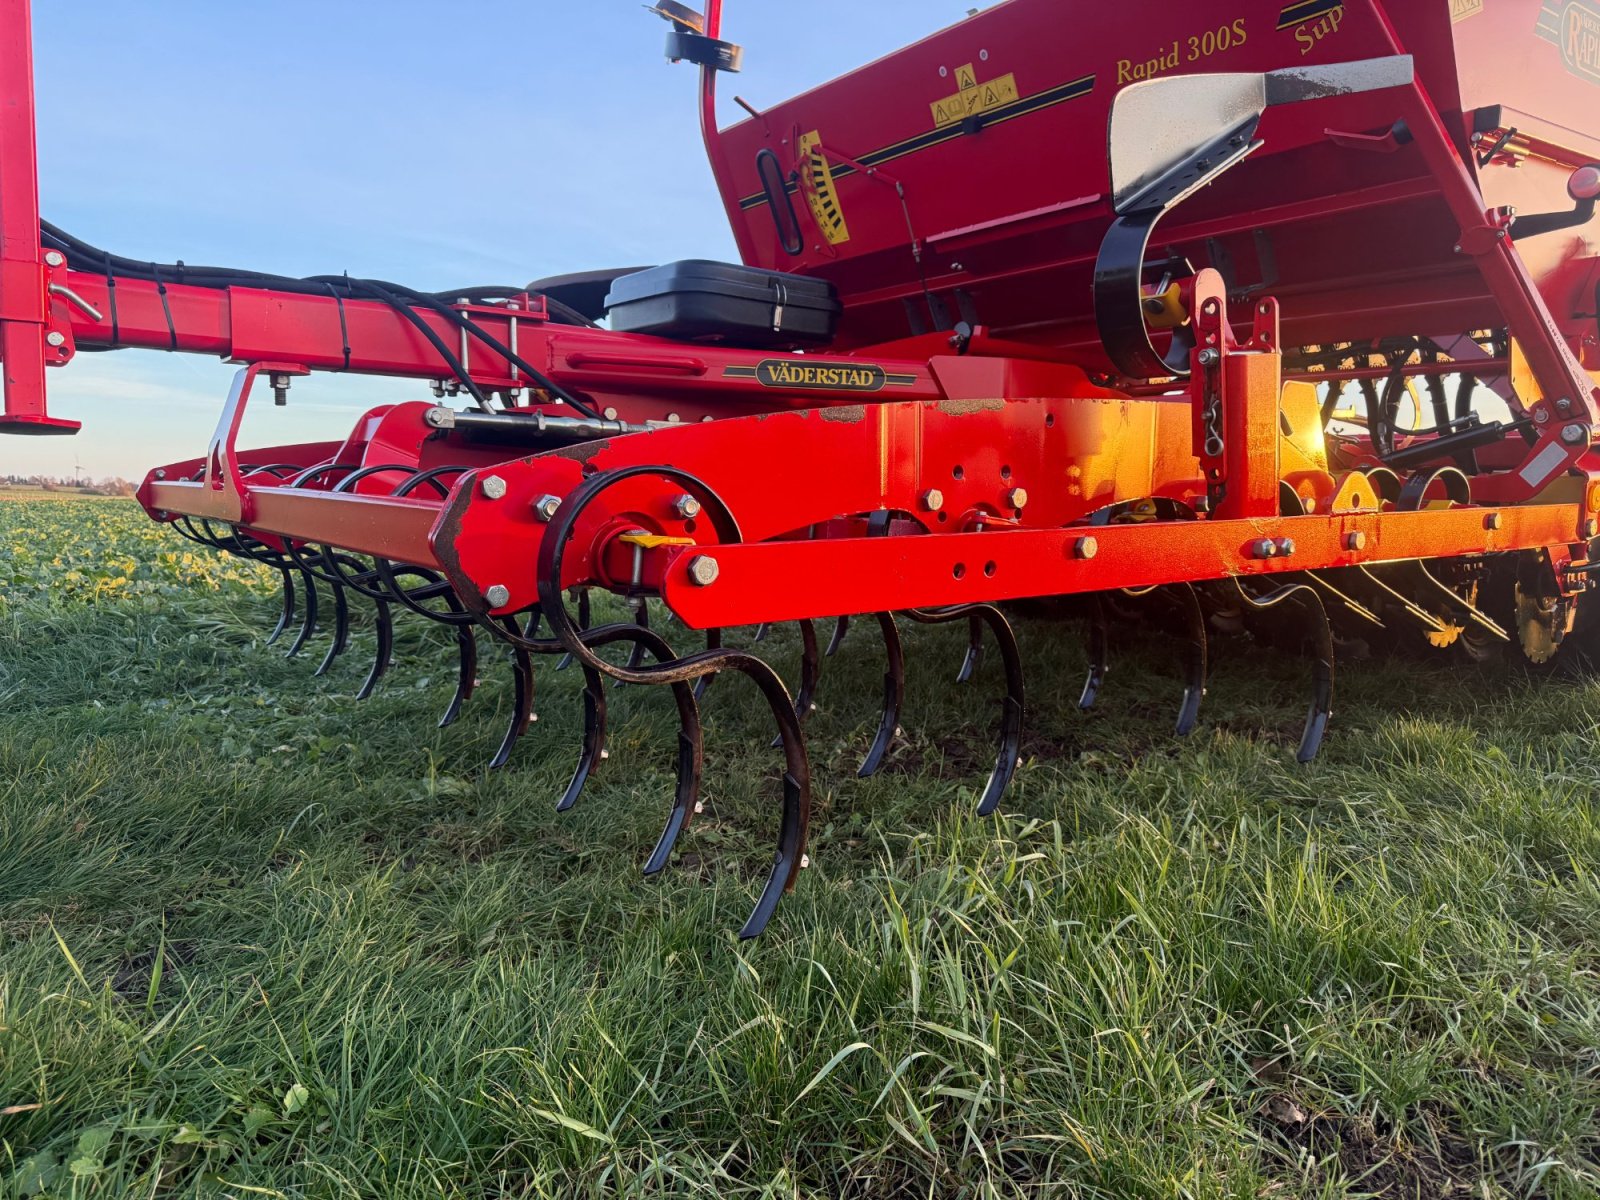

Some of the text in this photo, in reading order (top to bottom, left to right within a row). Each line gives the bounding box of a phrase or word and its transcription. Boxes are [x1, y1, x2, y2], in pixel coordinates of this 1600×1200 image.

[1116, 18, 1248, 86] Rapid 300S
[1294, 4, 1343, 56] Sup
[1567, 9, 1600, 69] RAPI
[767, 362, 874, 387] VÄDERSTAD
